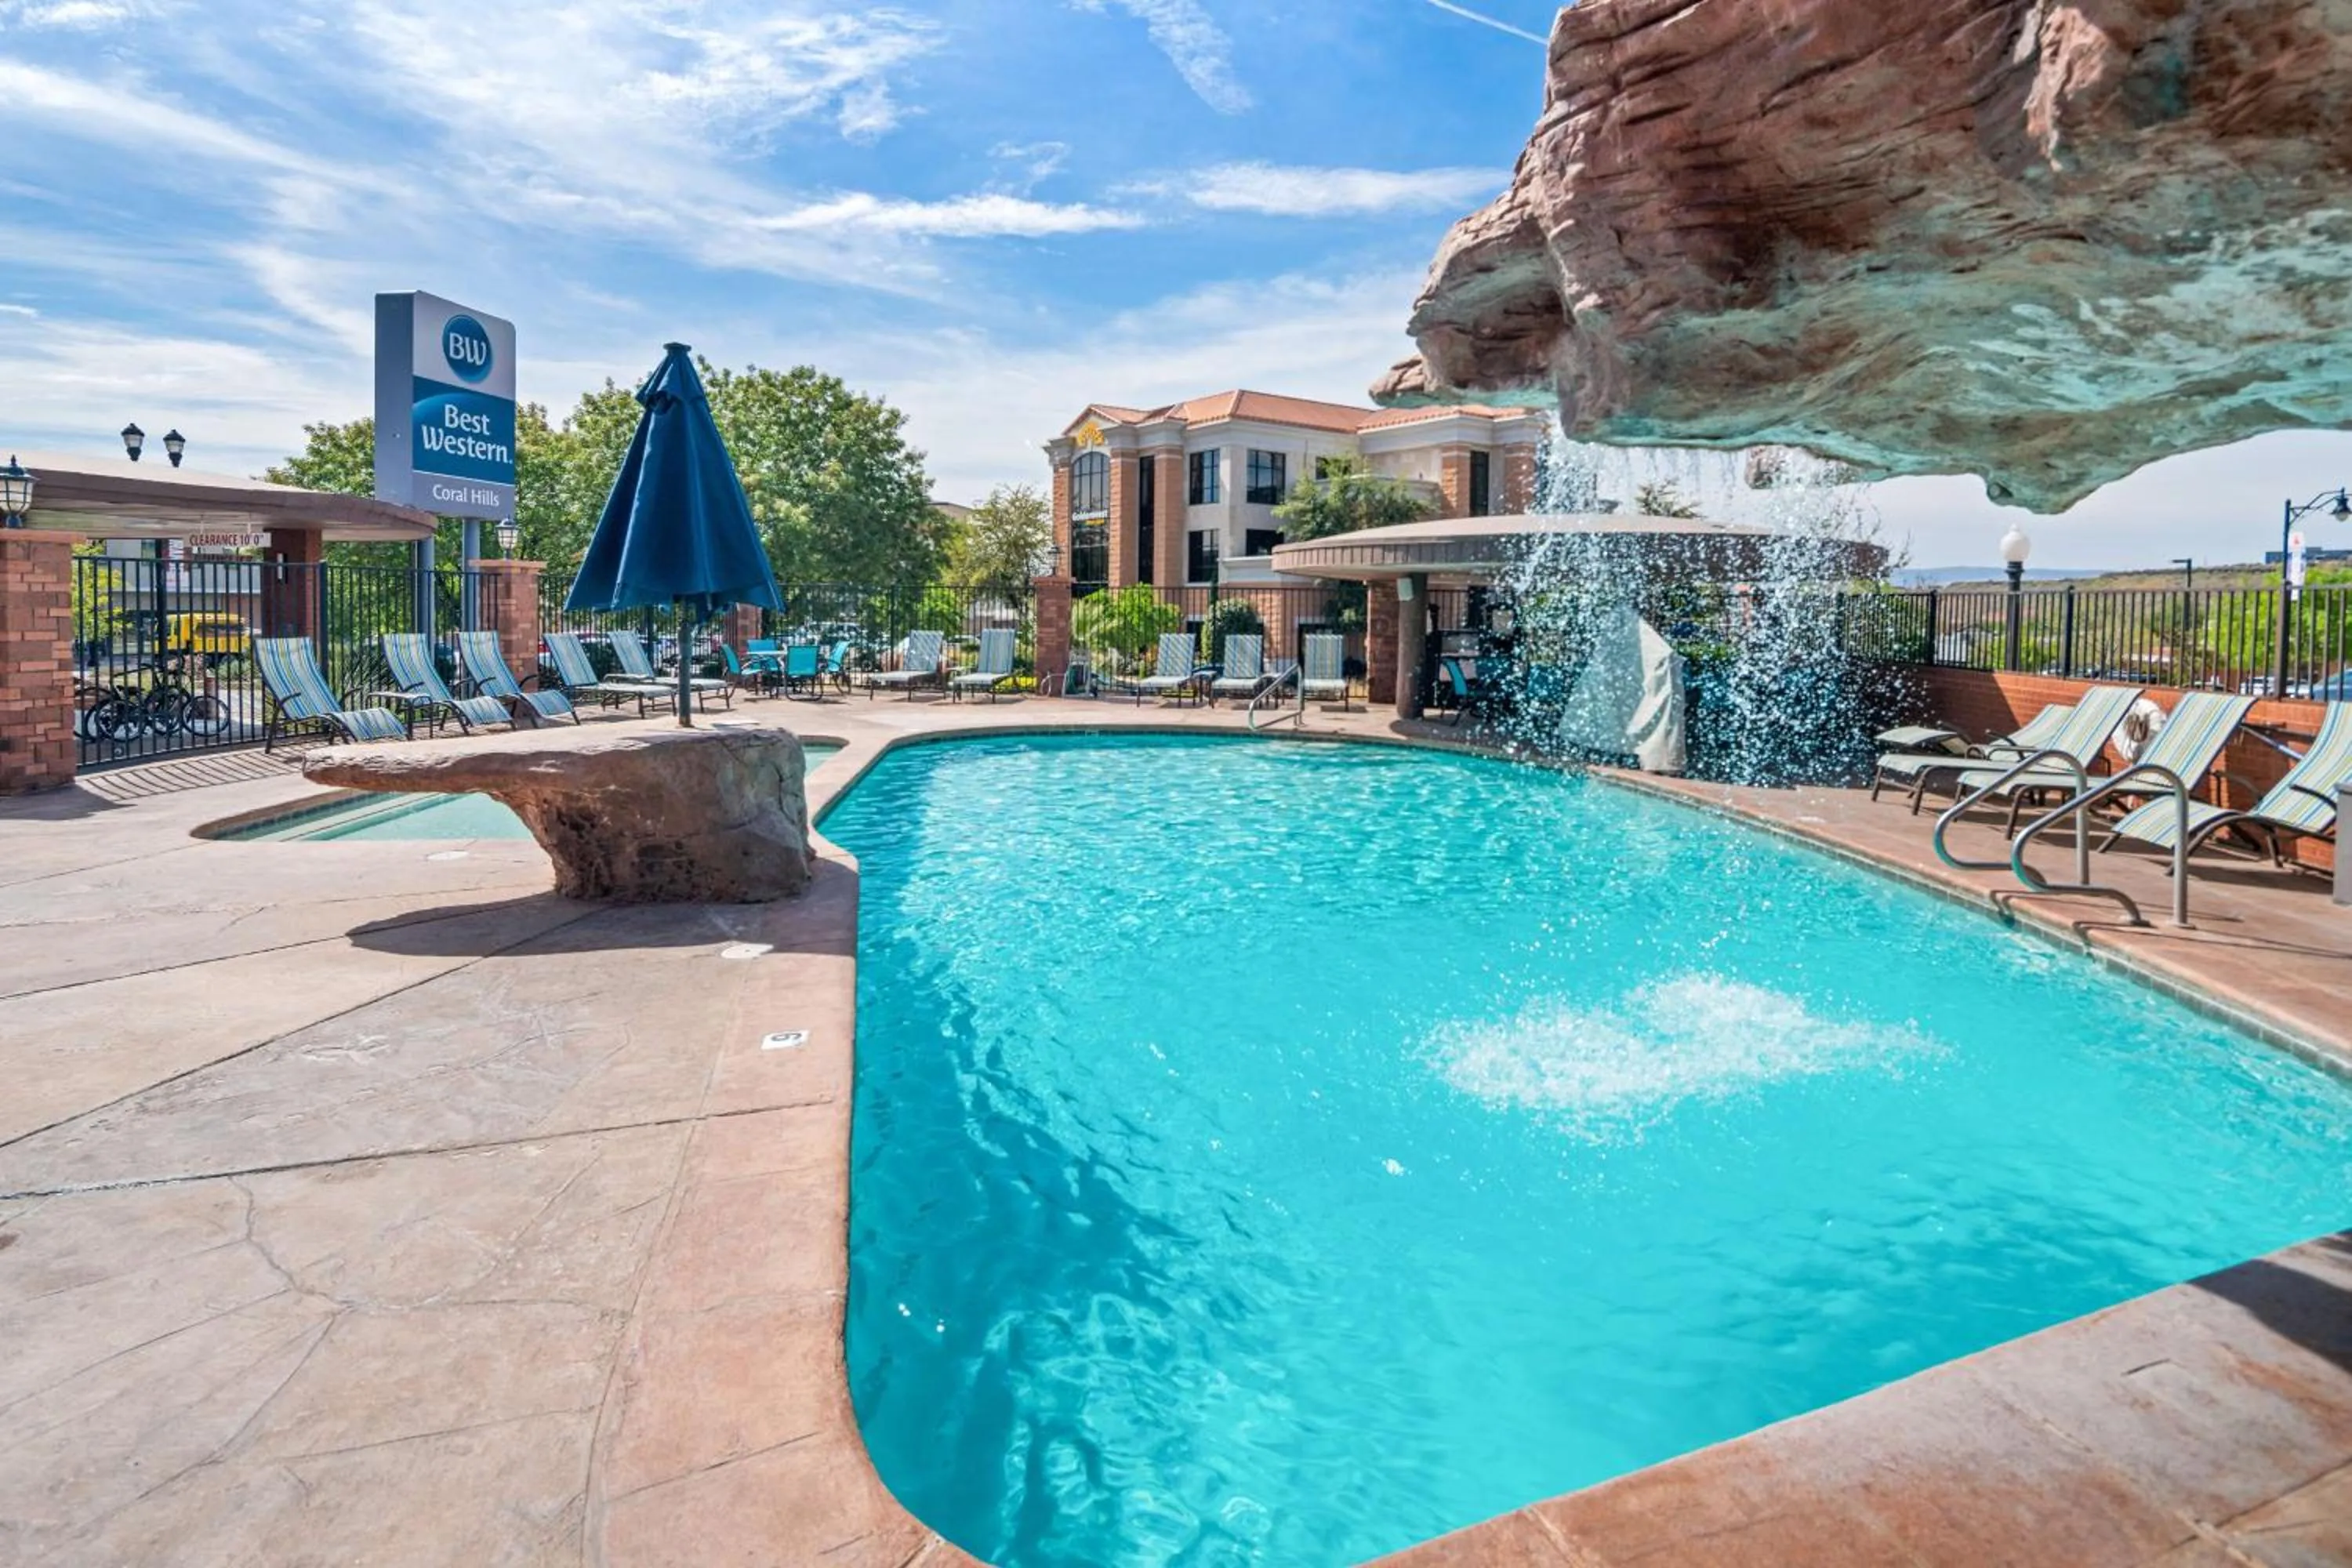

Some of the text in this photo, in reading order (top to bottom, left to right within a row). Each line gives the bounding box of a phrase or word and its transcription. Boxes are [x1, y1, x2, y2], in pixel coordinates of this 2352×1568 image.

[449, 332, 487, 366] BW
[445, 404, 490, 435] Best
[432, 484, 500, 507] Coral Hills
[189, 534, 238, 546] CLEARANCE
